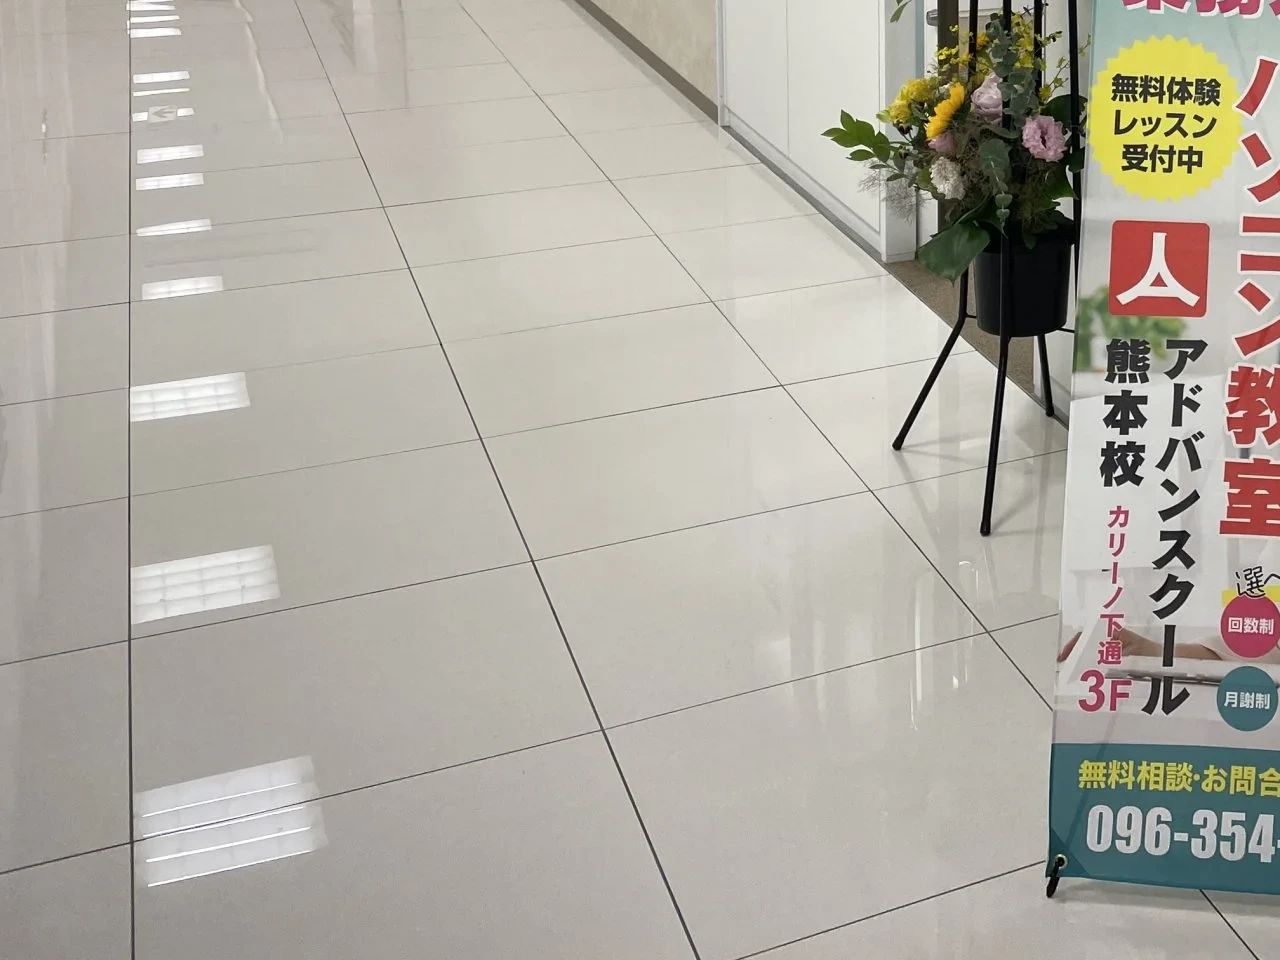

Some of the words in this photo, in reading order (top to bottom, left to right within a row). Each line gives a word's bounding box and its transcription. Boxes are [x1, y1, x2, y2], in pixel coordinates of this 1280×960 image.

[1111, 74, 1221, 107] 無料体験
[1113, 109, 1217, 139] レッスン
[1121, 144, 1203, 174] 受付中
[1100, 339, 1151, 487] 熊本校
[1142, 339, 1208, 716] アドバンスクール
[1097, 505, 1130, 665] カリーノ下通
[1228, 617, 1274, 635] 回数制
[1078, 669, 1132, 713] 3F
[1224, 692, 1270, 709] 月謝制
